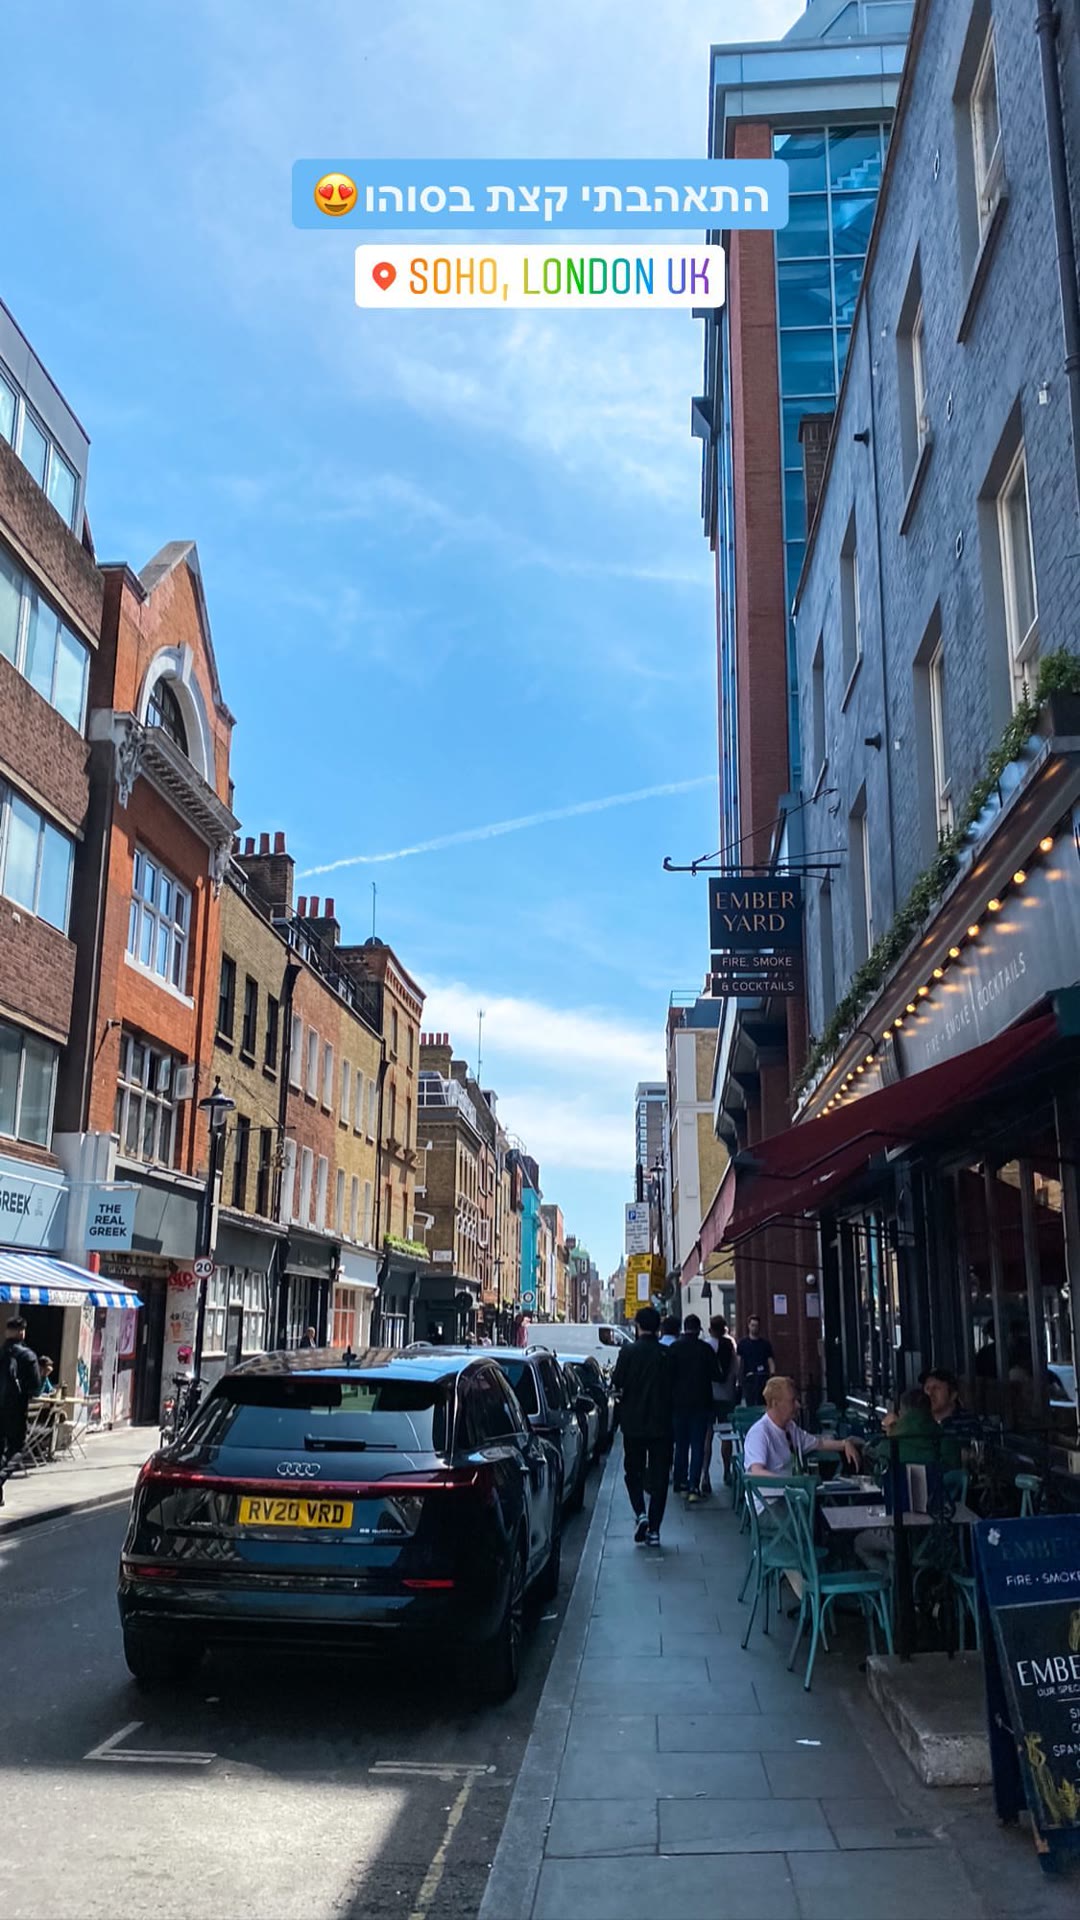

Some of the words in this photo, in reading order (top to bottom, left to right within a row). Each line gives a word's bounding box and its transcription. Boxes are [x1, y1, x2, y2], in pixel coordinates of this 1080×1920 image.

[716, 891, 796, 909] EMBER
[723, 913, 785, 932] YARD
[753, 957, 792, 967] SMOKE
[721, 982, 729, 991] &
[732, 981, 795, 991] COCKTAILS
[977, 951, 1026, 1011] COCKTAILS
[0, 1189, 31, 1216] REEK
[99, 1203, 121, 1214] THE
[94, 1215, 125, 1225] REAL
[89, 1226, 127, 1237] GREEK
[196, 1262, 212, 1273] 20
[248, 1501, 300, 1522] RV20
[307, 1504, 345, 1524] VRD
[1006, 1573, 1033, 1587] FIRE
